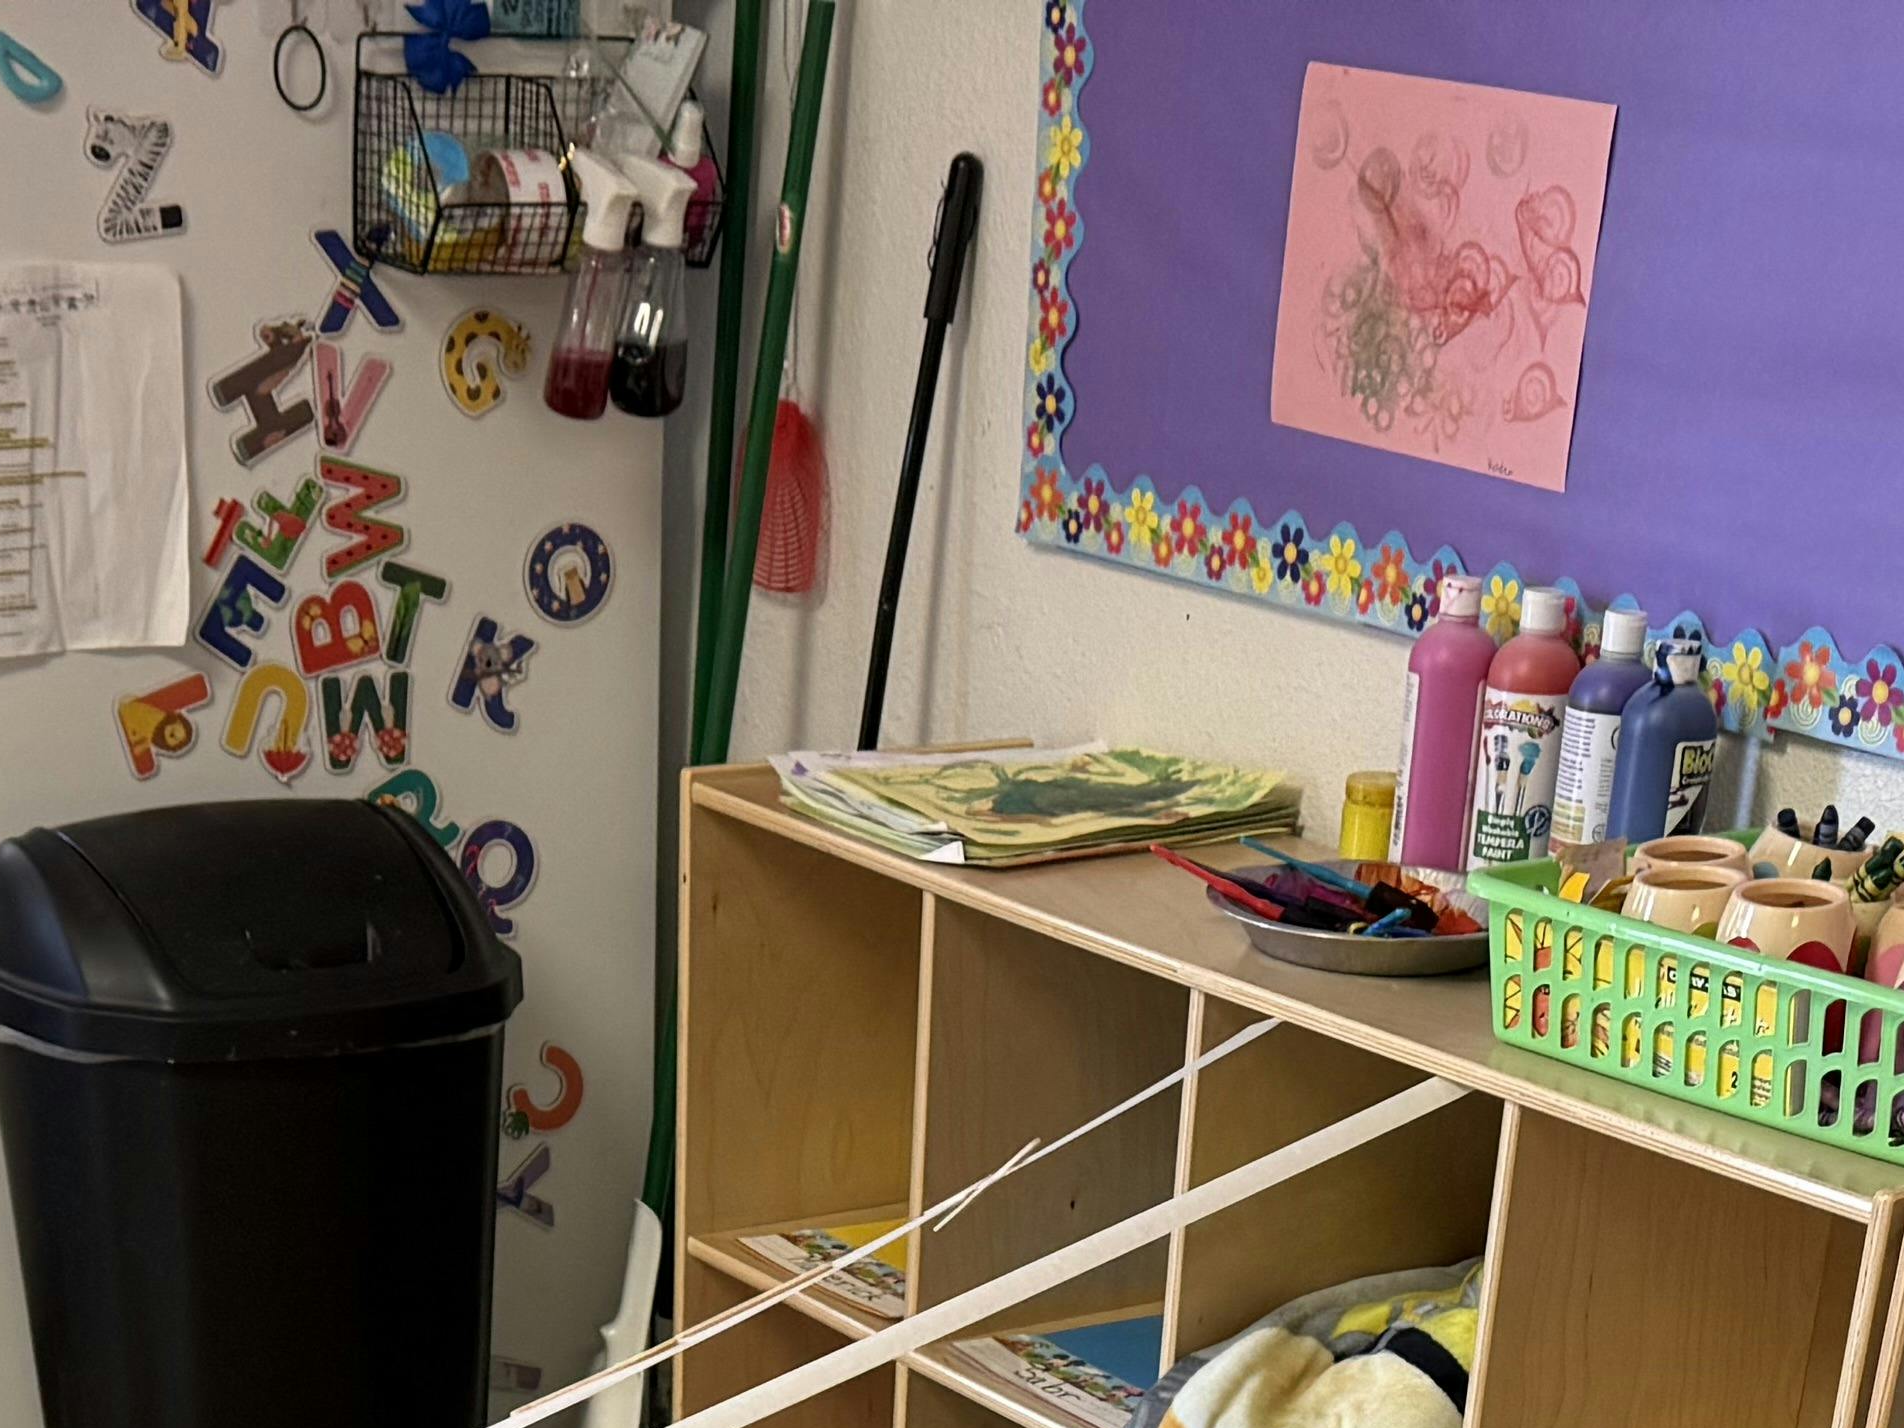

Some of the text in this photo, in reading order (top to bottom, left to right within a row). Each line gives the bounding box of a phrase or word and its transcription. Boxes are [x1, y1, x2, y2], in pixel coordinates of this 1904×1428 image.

[311, 228, 401, 335] X
[313, 341, 393, 450] V
[292, 579, 384, 677] B
[451, 615, 537, 731] K
